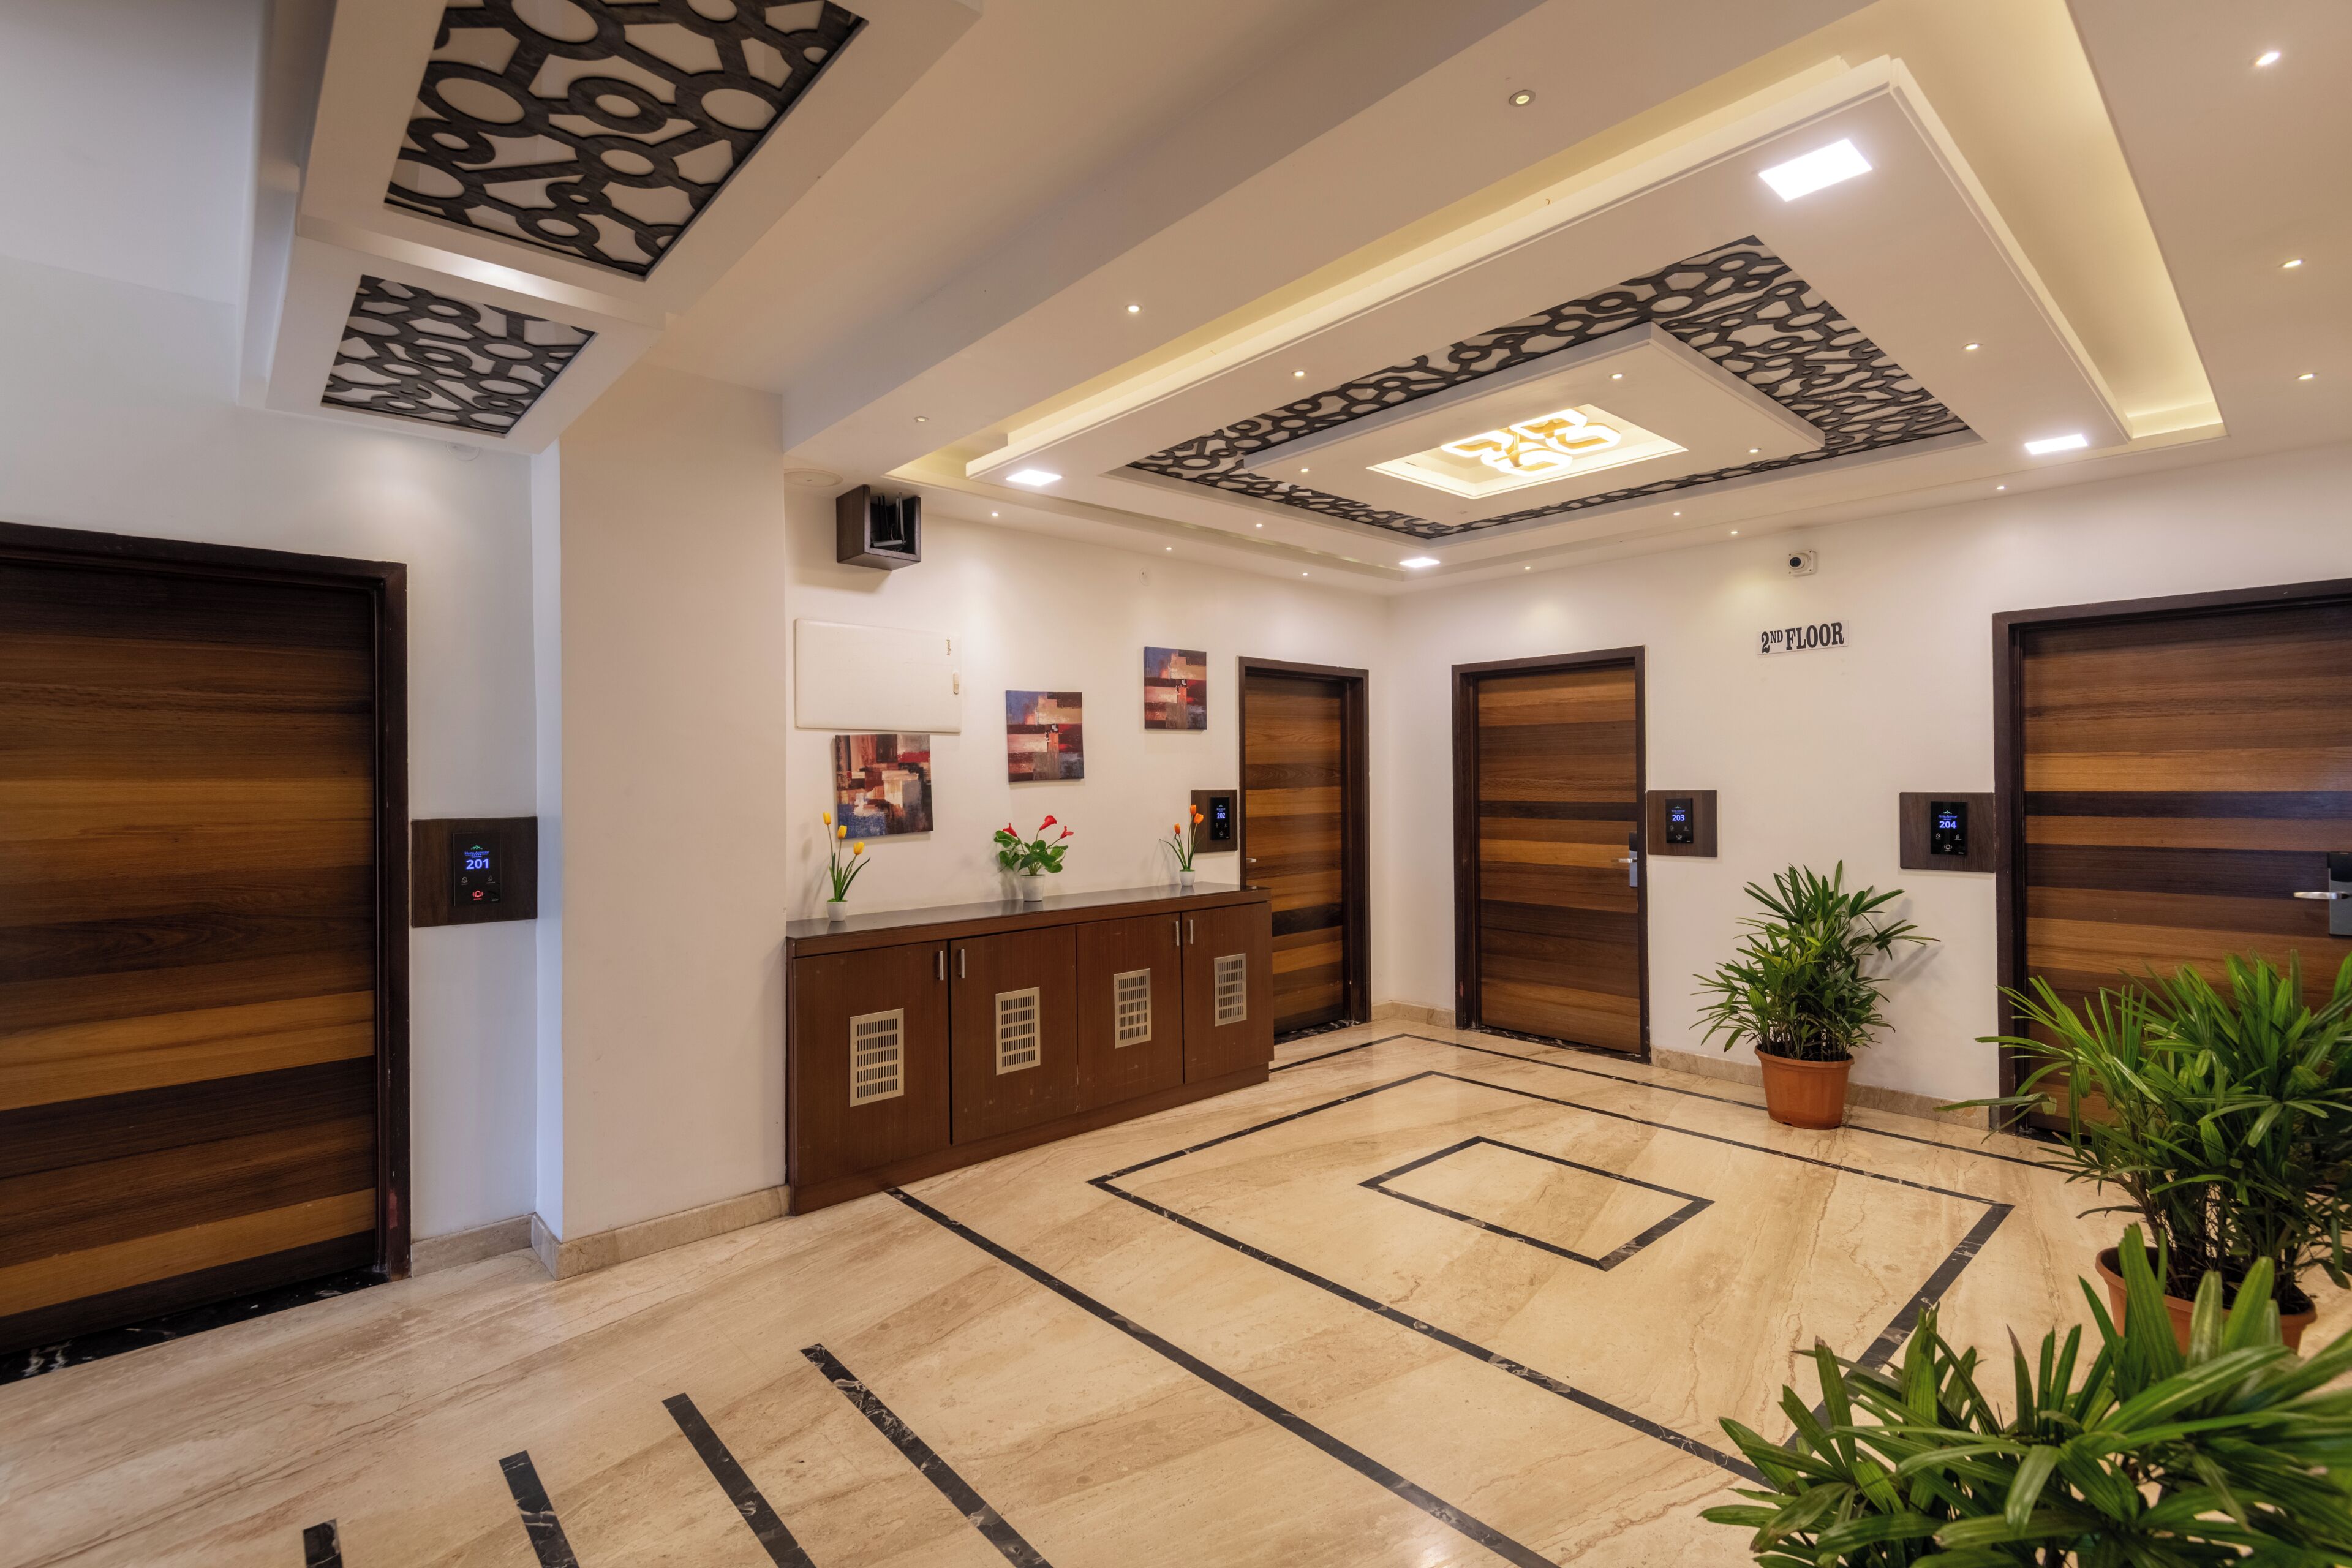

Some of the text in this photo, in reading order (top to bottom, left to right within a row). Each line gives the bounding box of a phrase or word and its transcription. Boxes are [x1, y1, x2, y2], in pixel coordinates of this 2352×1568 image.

[1761, 622, 1845, 654] 2ND FLOOR
[466, 858, 489, 870] 201
